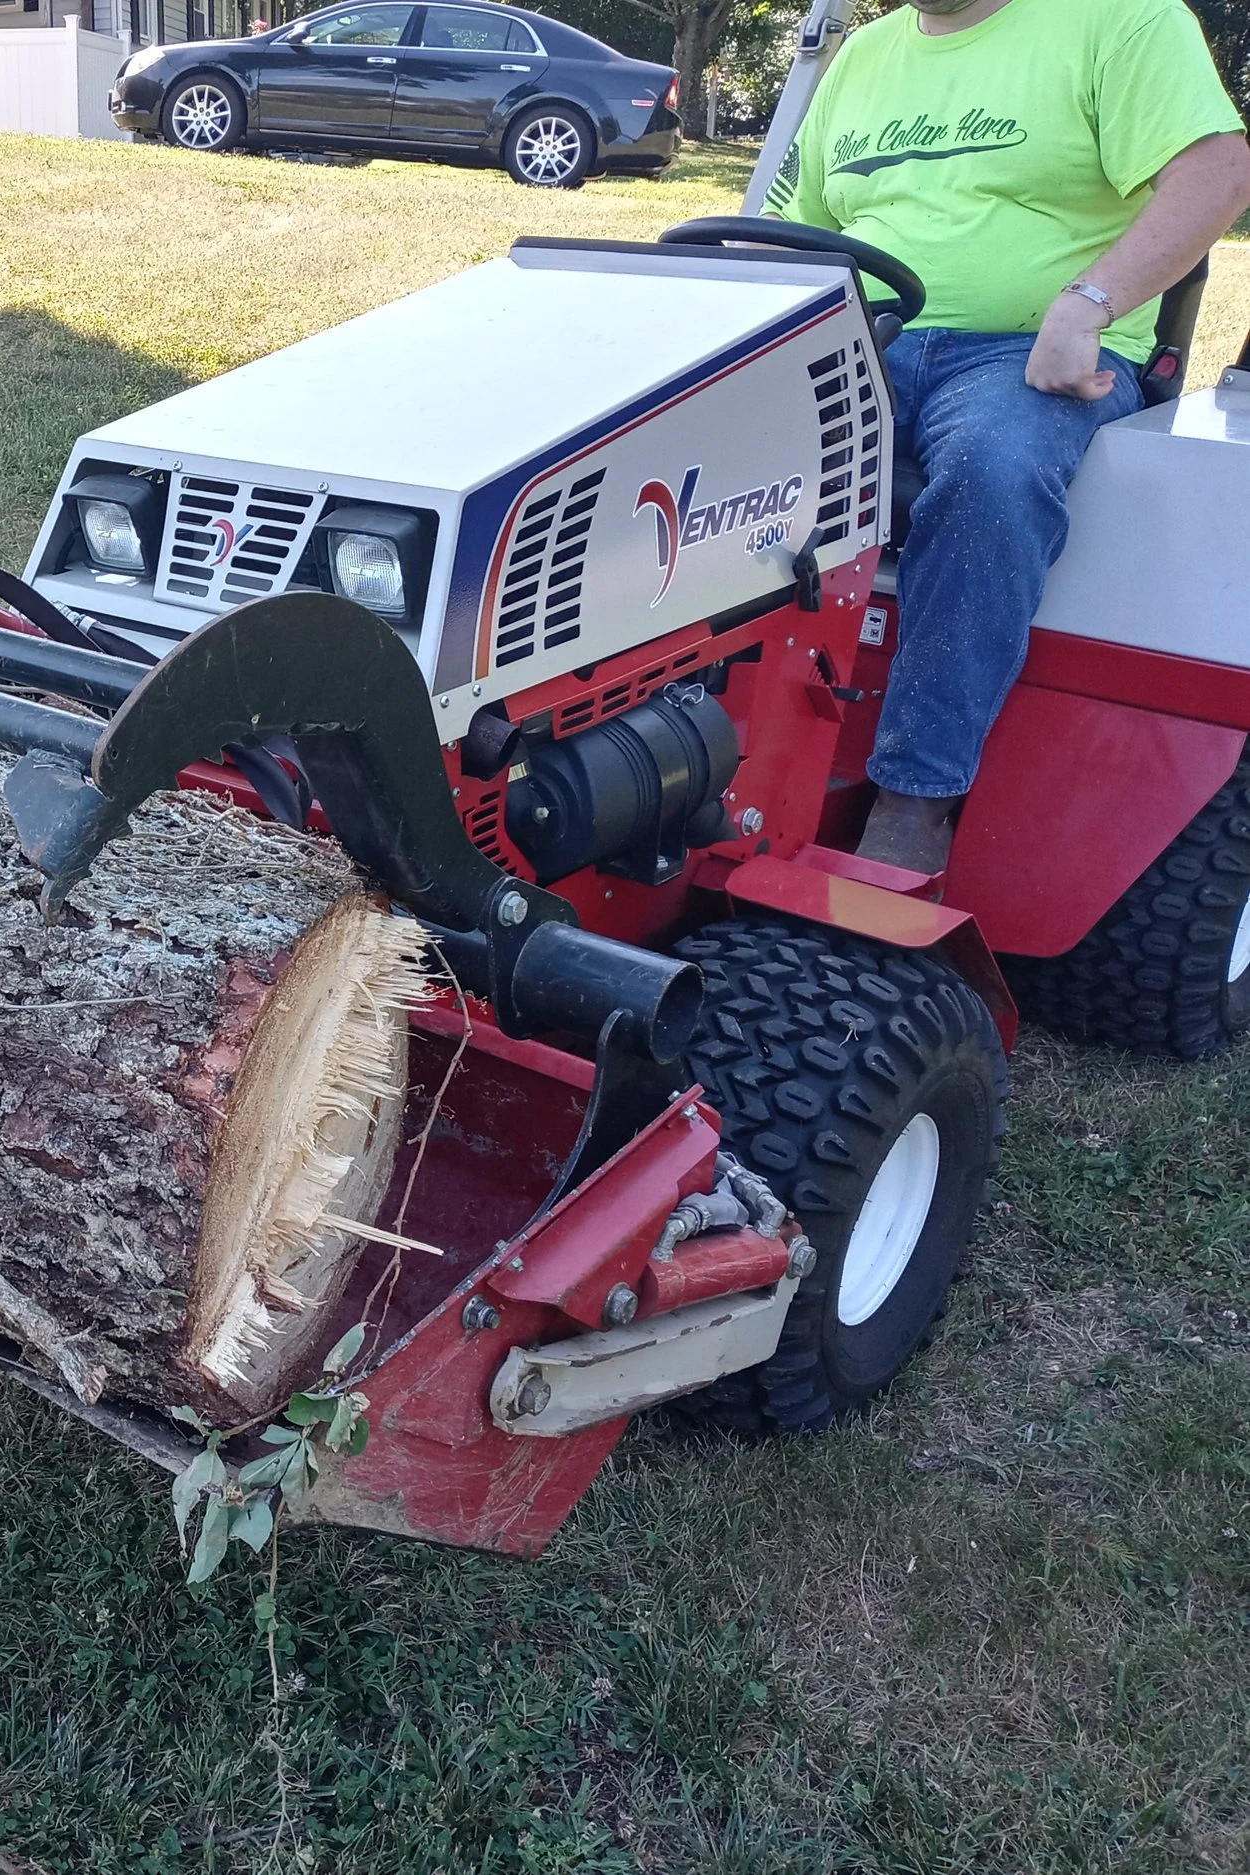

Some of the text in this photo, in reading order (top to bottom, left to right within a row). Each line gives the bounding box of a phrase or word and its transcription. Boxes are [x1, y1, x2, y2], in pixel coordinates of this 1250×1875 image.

[831, 108, 1019, 168] Blue Collar Hero
[633, 464, 803, 608] VENTRAC
[745, 518, 793, 555] 4500Y
